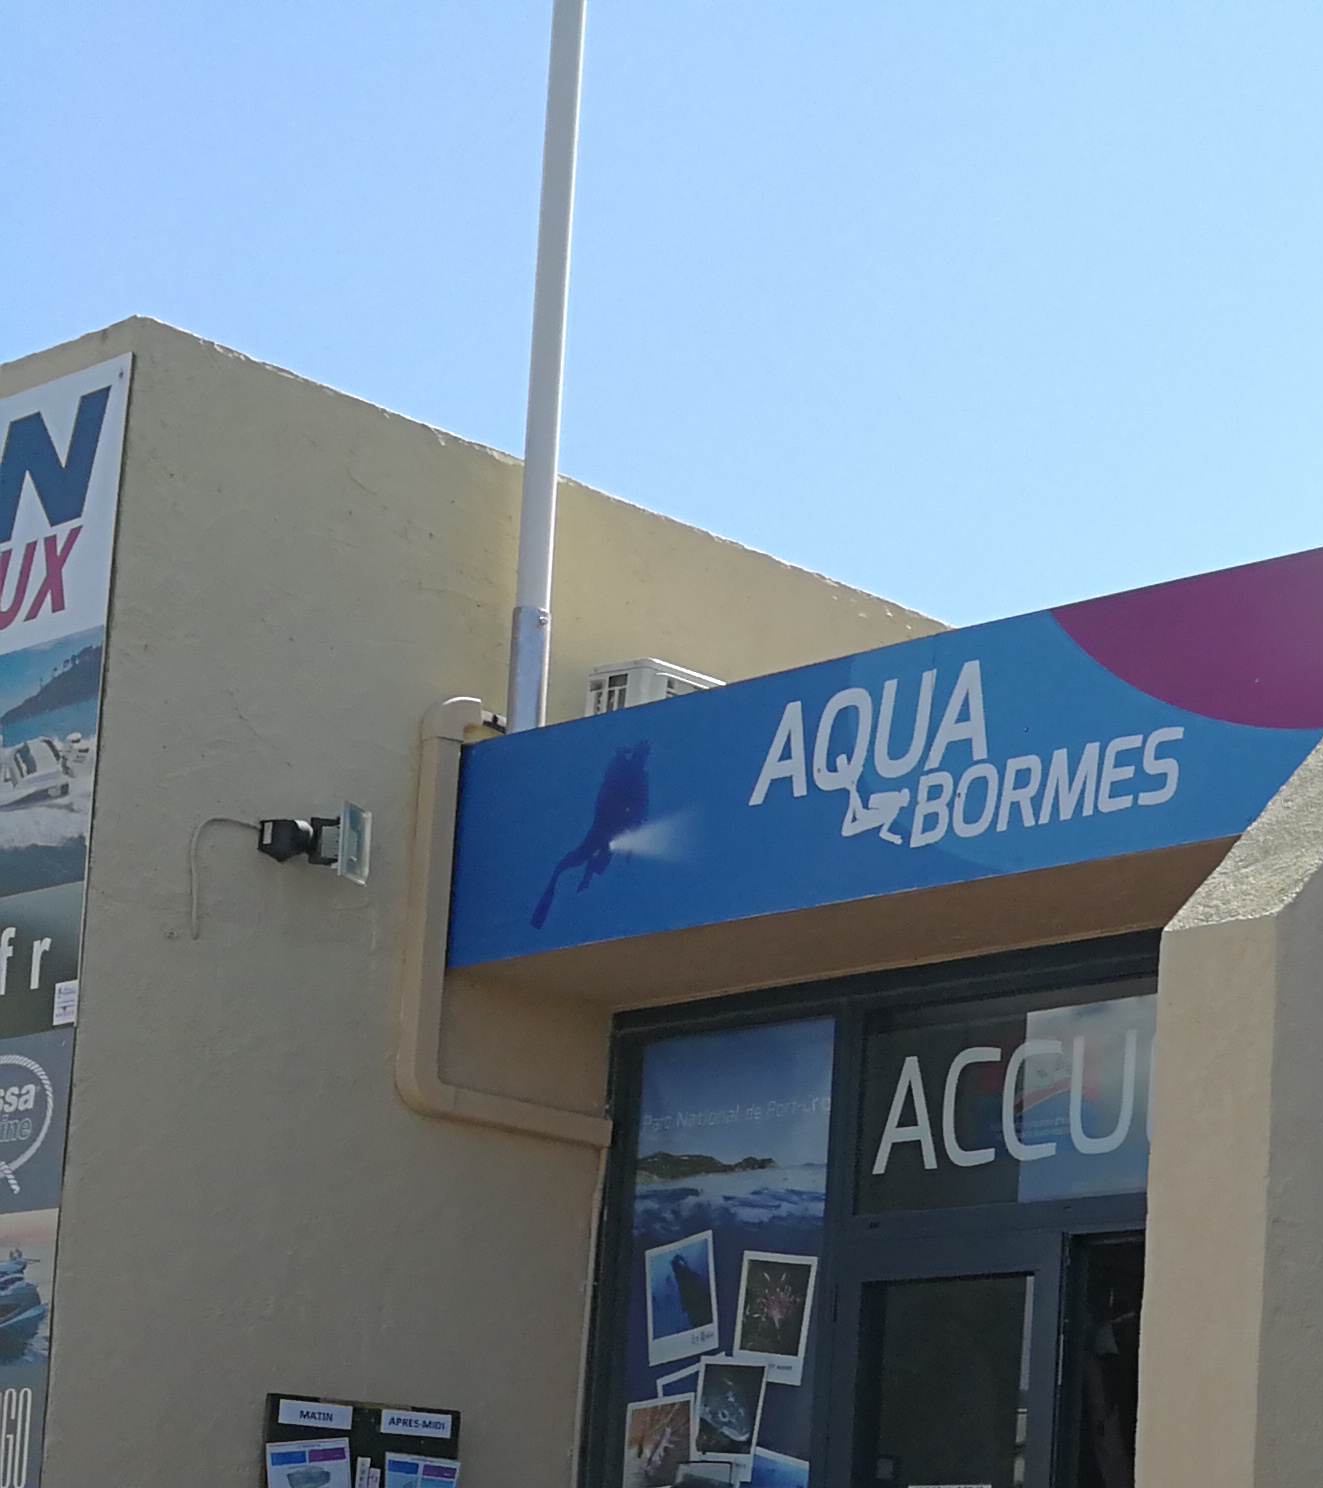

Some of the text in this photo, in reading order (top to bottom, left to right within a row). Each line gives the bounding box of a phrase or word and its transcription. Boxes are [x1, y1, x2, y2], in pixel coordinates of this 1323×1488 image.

[748, 659, 988, 808] AQUA
[909, 726, 1185, 849] BORMES
[676, 1104, 740, 1129] National
[871, 1028, 1156, 1175] ACCU
[299, 1410, 334, 1422] MATIN
[388, 1416, 446, 1431] APRES-MIDI
